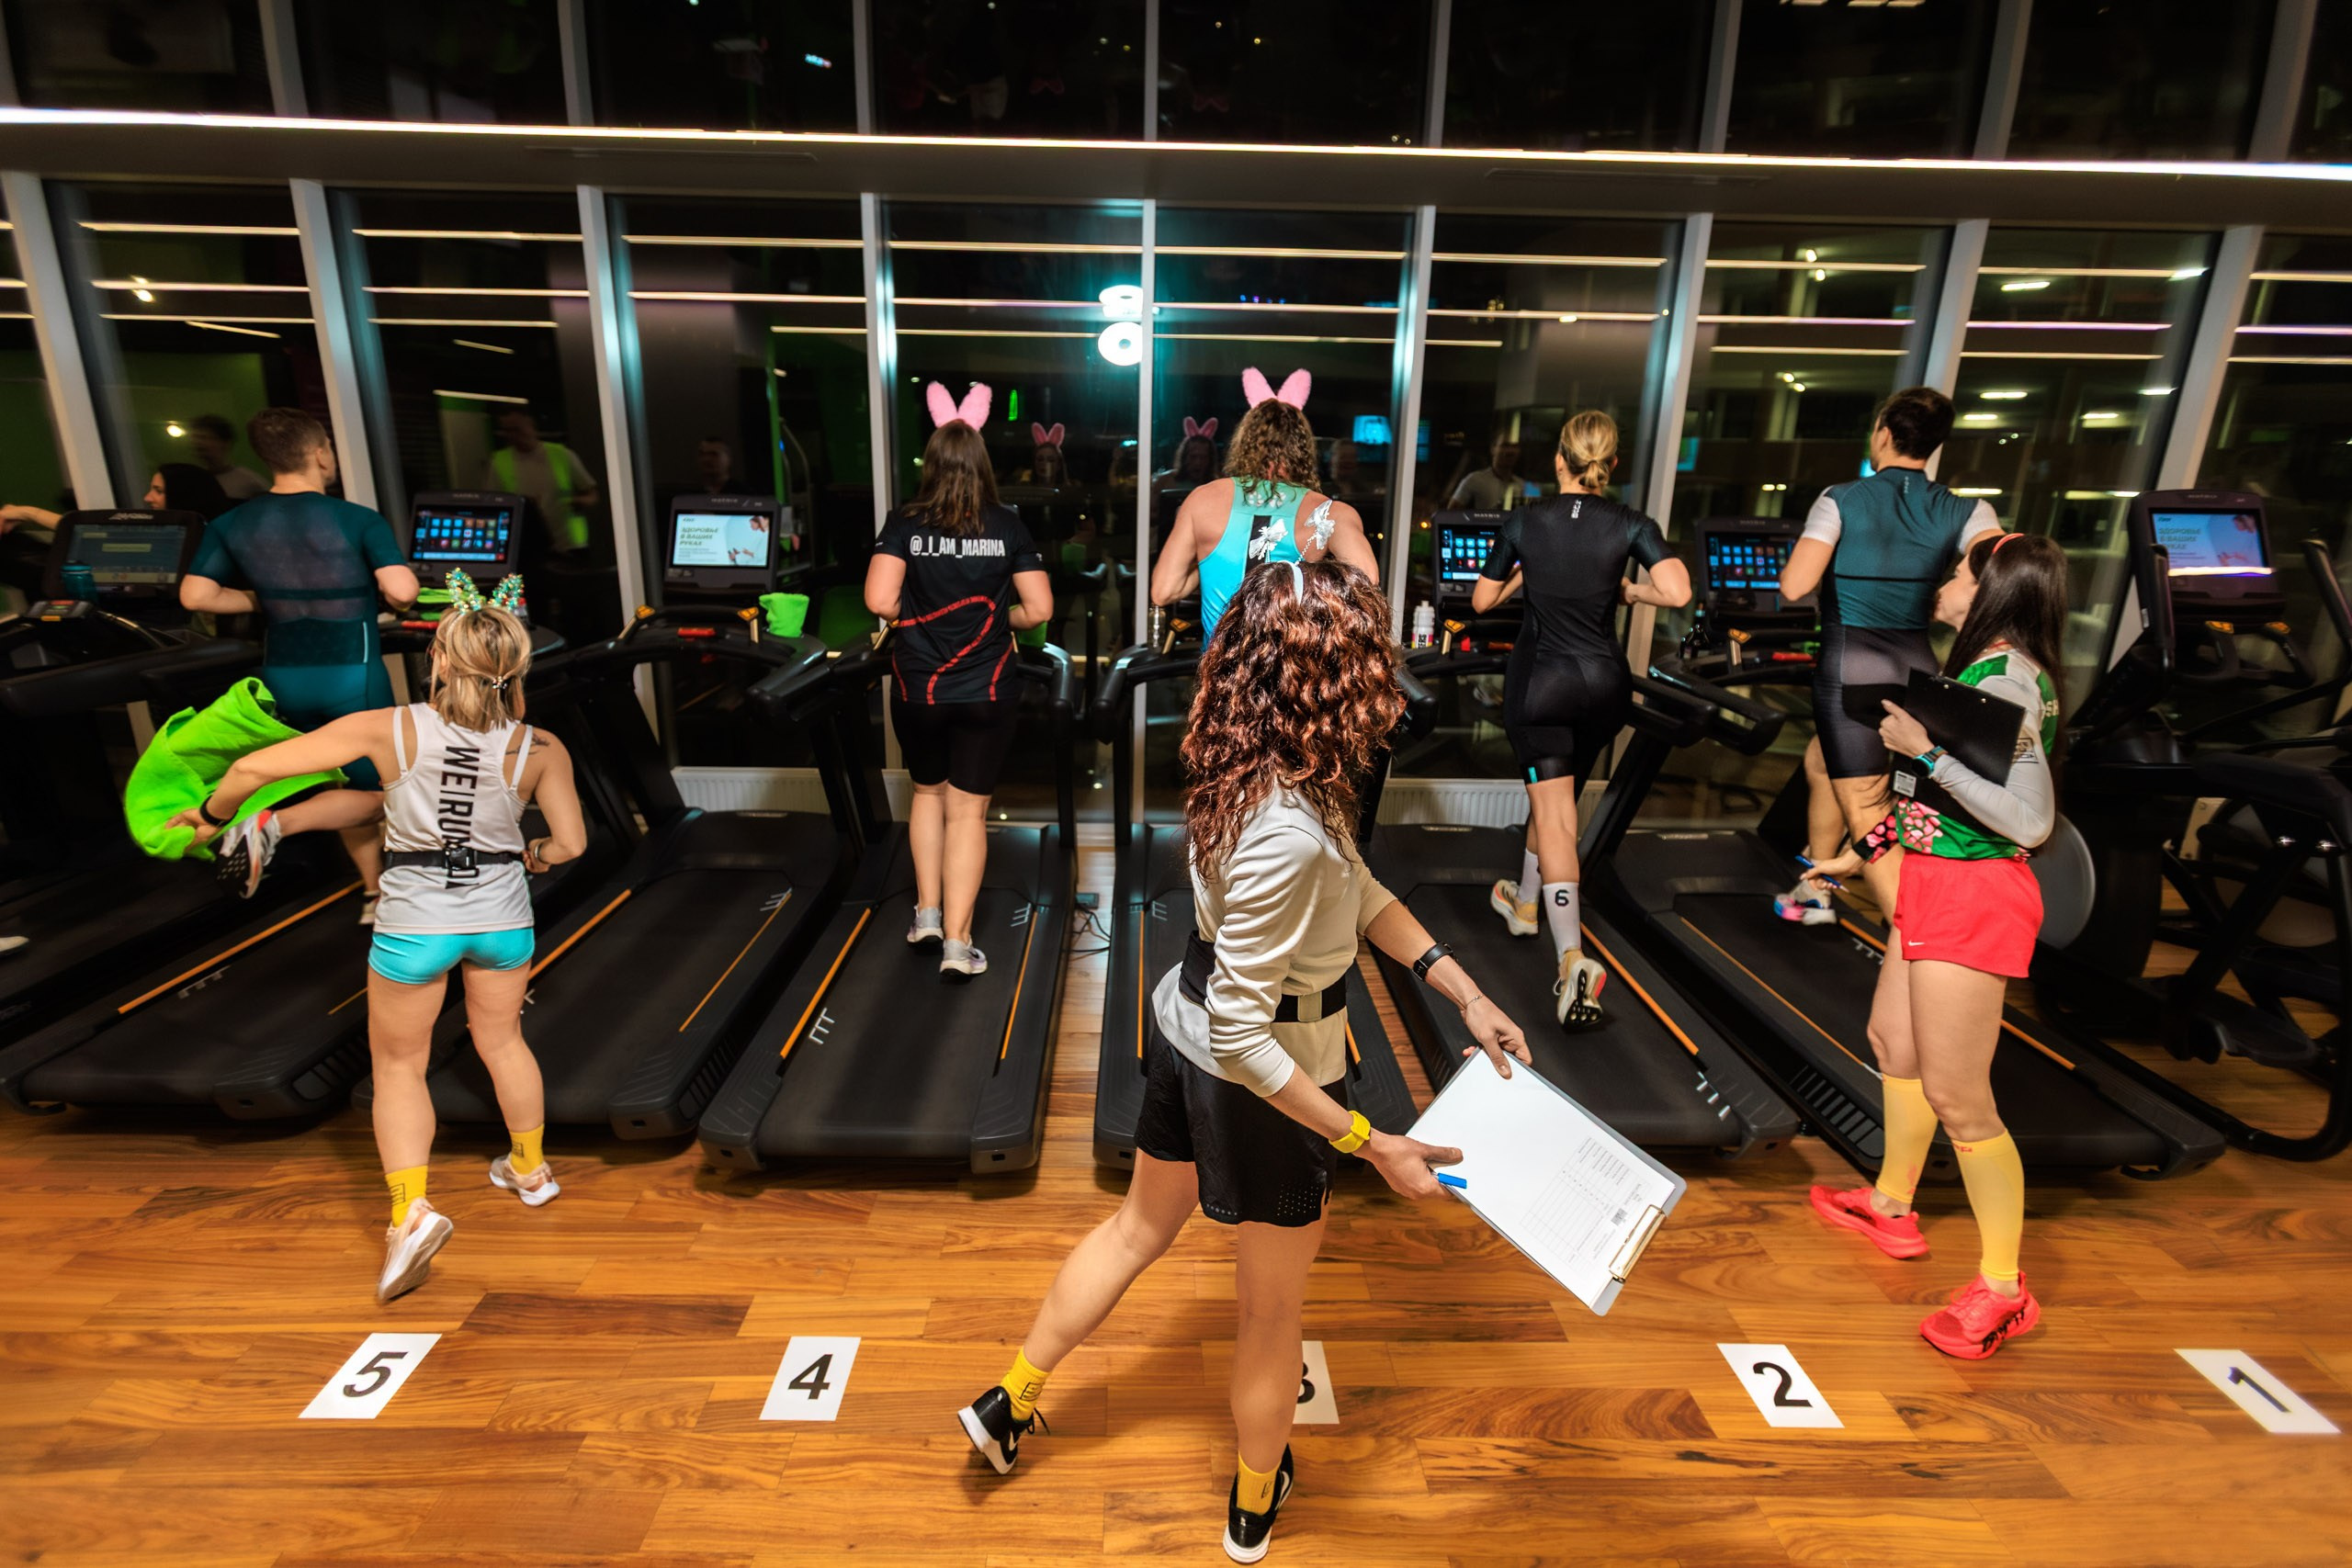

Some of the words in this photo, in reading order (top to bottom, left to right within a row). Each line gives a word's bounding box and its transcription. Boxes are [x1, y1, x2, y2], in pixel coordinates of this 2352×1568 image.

[910, 535, 1006, 558] @_I_AM_MARINA
[1555, 889, 1569, 908] 6
[343, 1351, 410, 1398] 5
[787, 1353, 834, 1400] 4
[1752, 1361, 1814, 1408] 2
[2227, 1366, 2293, 1413] 1
